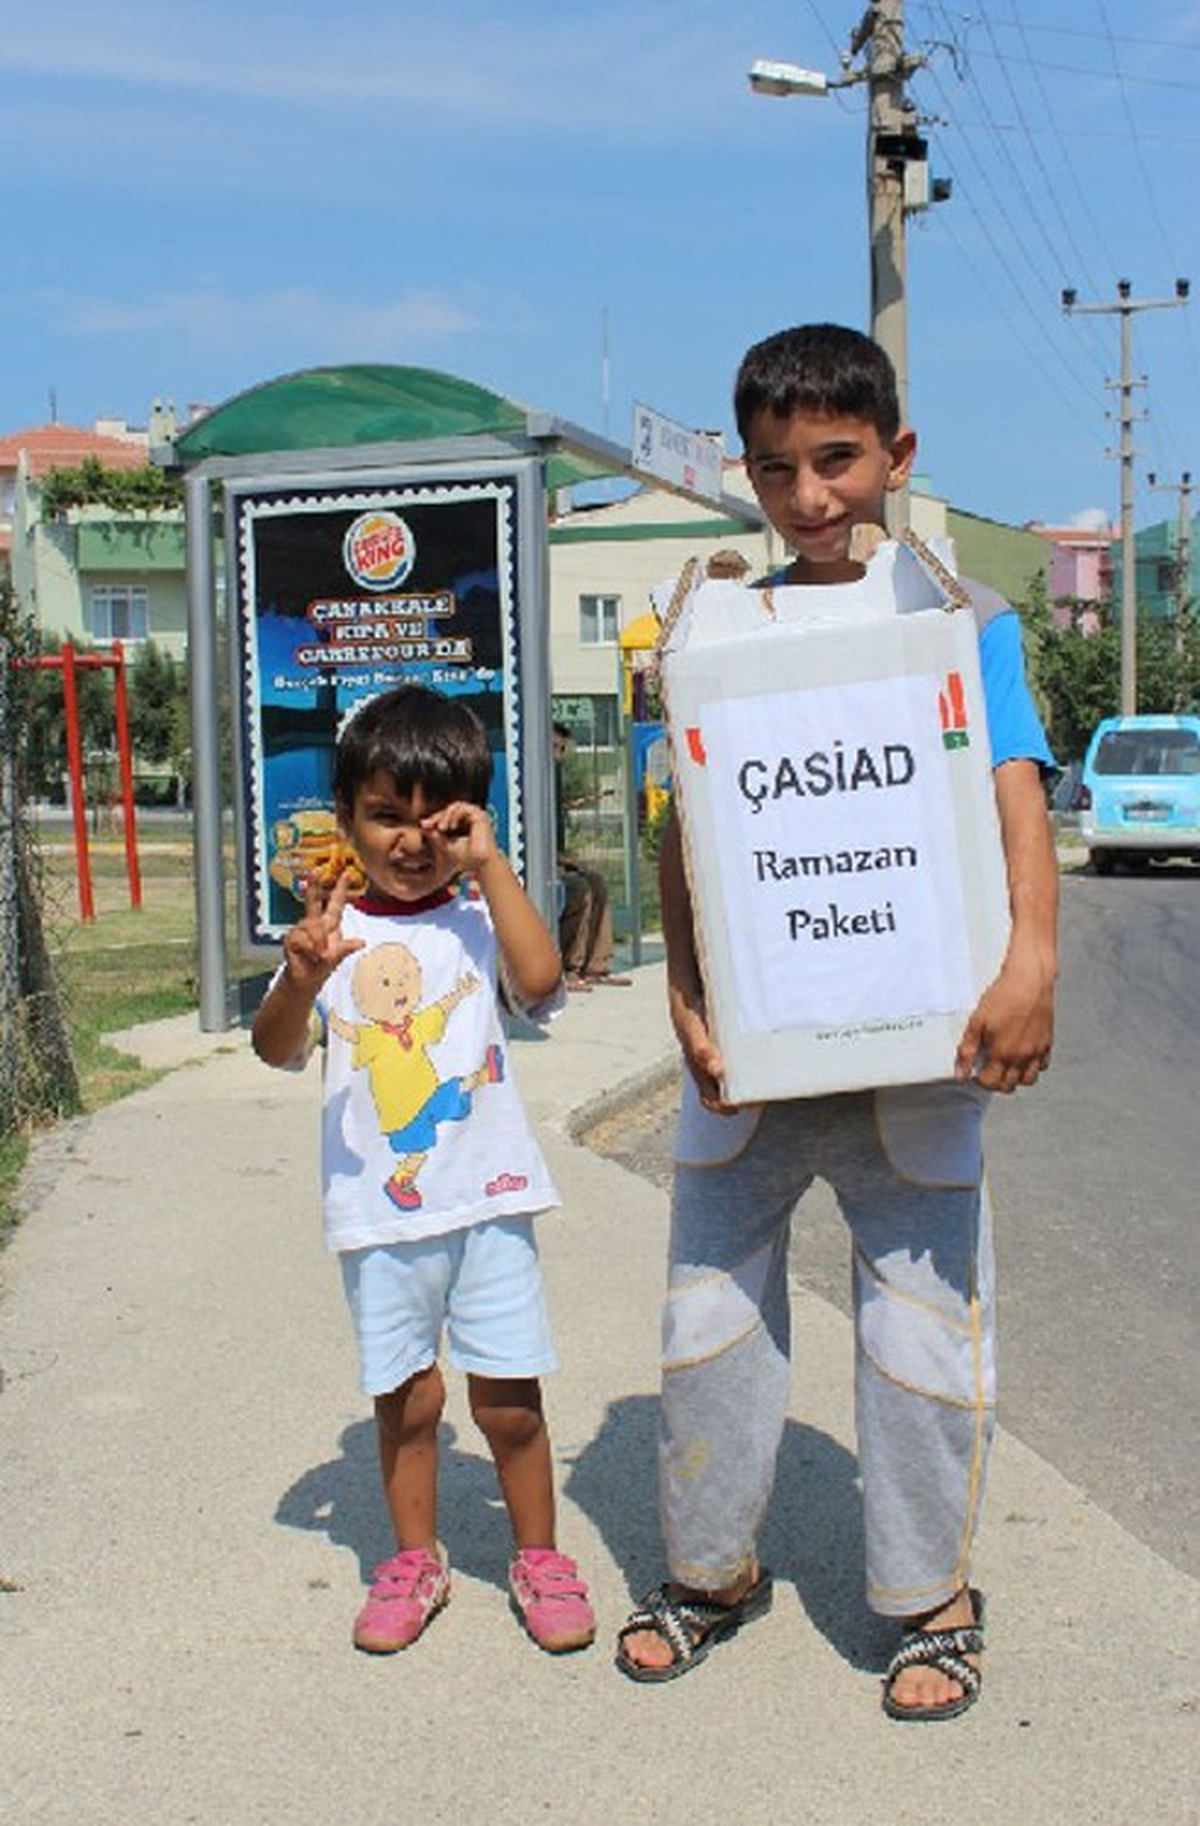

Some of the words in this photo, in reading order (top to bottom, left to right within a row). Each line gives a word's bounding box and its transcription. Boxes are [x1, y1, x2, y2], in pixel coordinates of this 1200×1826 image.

[356, 539, 406, 571] KING
[396, 621, 423, 637] VE
[738, 740, 916, 814] ÇASİAD
[753, 845, 918, 882] Ramazan
[786, 902, 896, 941] Paketi
